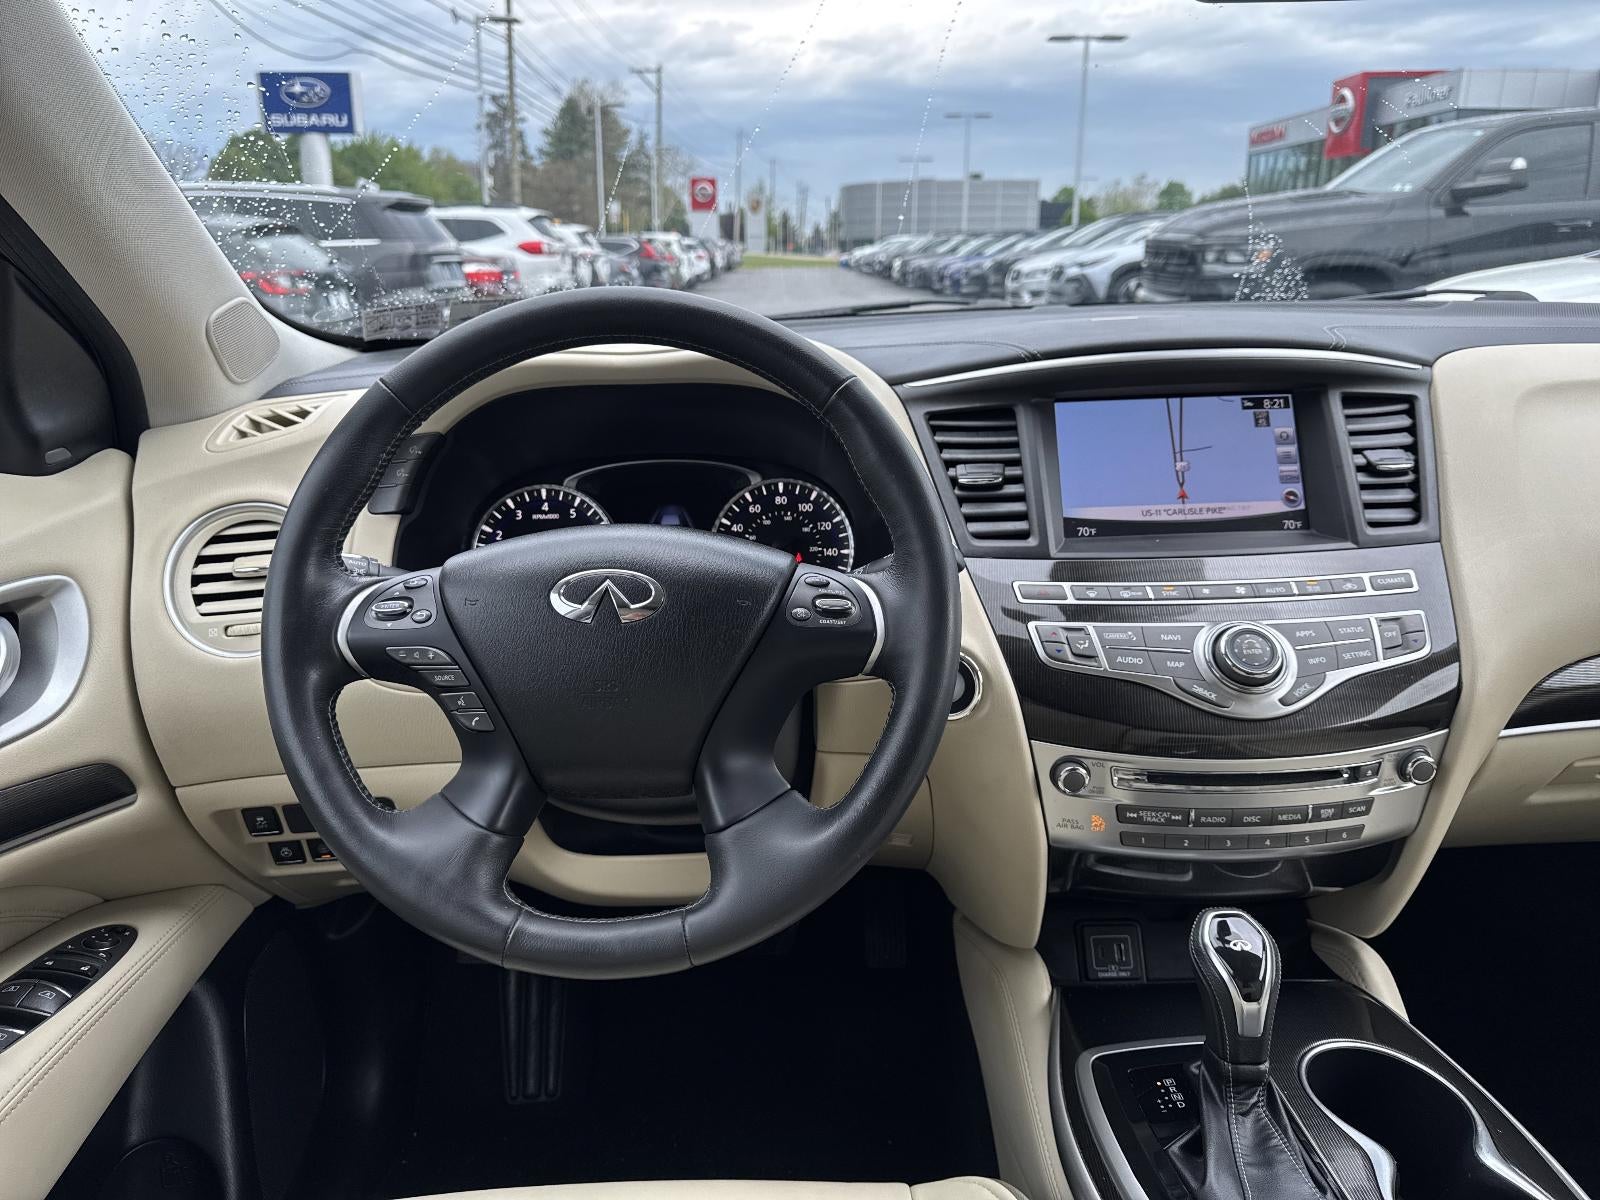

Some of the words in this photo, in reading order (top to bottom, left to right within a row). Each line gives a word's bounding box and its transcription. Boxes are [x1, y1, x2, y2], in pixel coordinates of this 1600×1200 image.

[269, 112, 348, 128] SUBARU
[1262, 398, 1285, 409] 8:21
[775, 495, 787, 505] 80
[541, 502, 549, 512] 4
[749, 504, 761, 513] 60
[798, 503, 813, 512] 100
[515, 510, 523, 520] 3
[569, 508, 577, 519] 5
[1141, 508, 1161, 517] US-11
[731, 525, 744, 533] 40
[817, 521, 832, 531] 120
[495, 531, 503, 541] 2
[823, 548, 838, 557] 140
[348, 559, 369, 568] AUTO
[1377, 576, 1406, 585] CLIMATE
[1295, 629, 1316, 637] APPS
[1338, 625, 1365, 634] STATUS
[1384, 630, 1396, 638] OFF
[1342, 649, 1372, 660] SETTING
[1116, 655, 1144, 665] AUDIO
[1166, 660, 1185, 668] MAP
[1307, 655, 1326, 664] INFO
[434, 674, 455, 682] SOURCE
[1199, 686, 1217, 701] BACK
[1091, 761, 1106, 769] VOL
[1348, 805, 1366, 813] SCAN
[1062, 817, 1079, 825] PASS
[1143, 816, 1166, 824] TRACK
[1243, 815, 1262, 823] DISC
[1278, 813, 1302, 821] MEDIA
[1056, 822, 1068, 830] AIR
[1070, 824, 1085, 832] BAG
[1304, 835, 1310, 843] 5
[1341, 831, 1347, 839] 6
[1141, 836, 1145, 844] 1
[1226, 839, 1231, 847] 3
